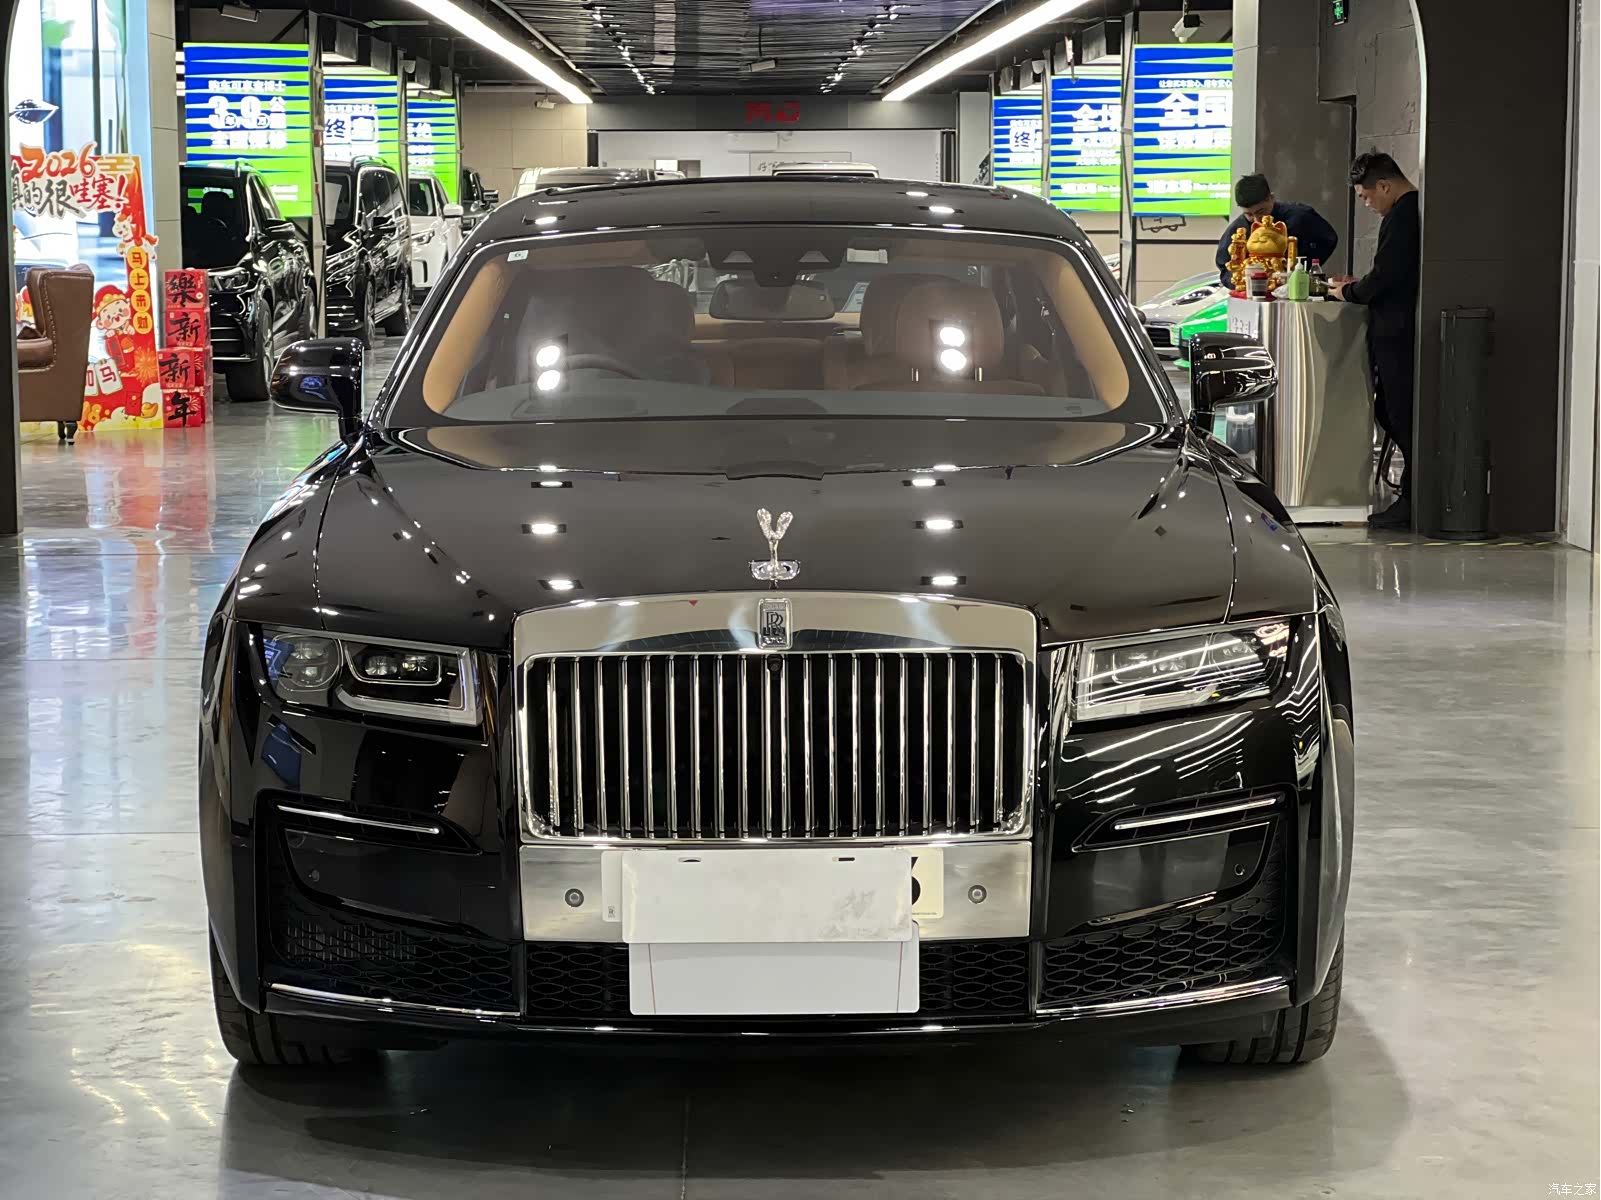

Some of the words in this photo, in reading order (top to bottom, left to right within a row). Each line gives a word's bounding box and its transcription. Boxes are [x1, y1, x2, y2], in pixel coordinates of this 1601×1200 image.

[20, 143, 96, 183] 2026
[169, 273, 201, 308] 樂
[168, 312, 201, 345] 新
[159, 353, 191, 384] 新
[168, 391, 197, 427] 年
